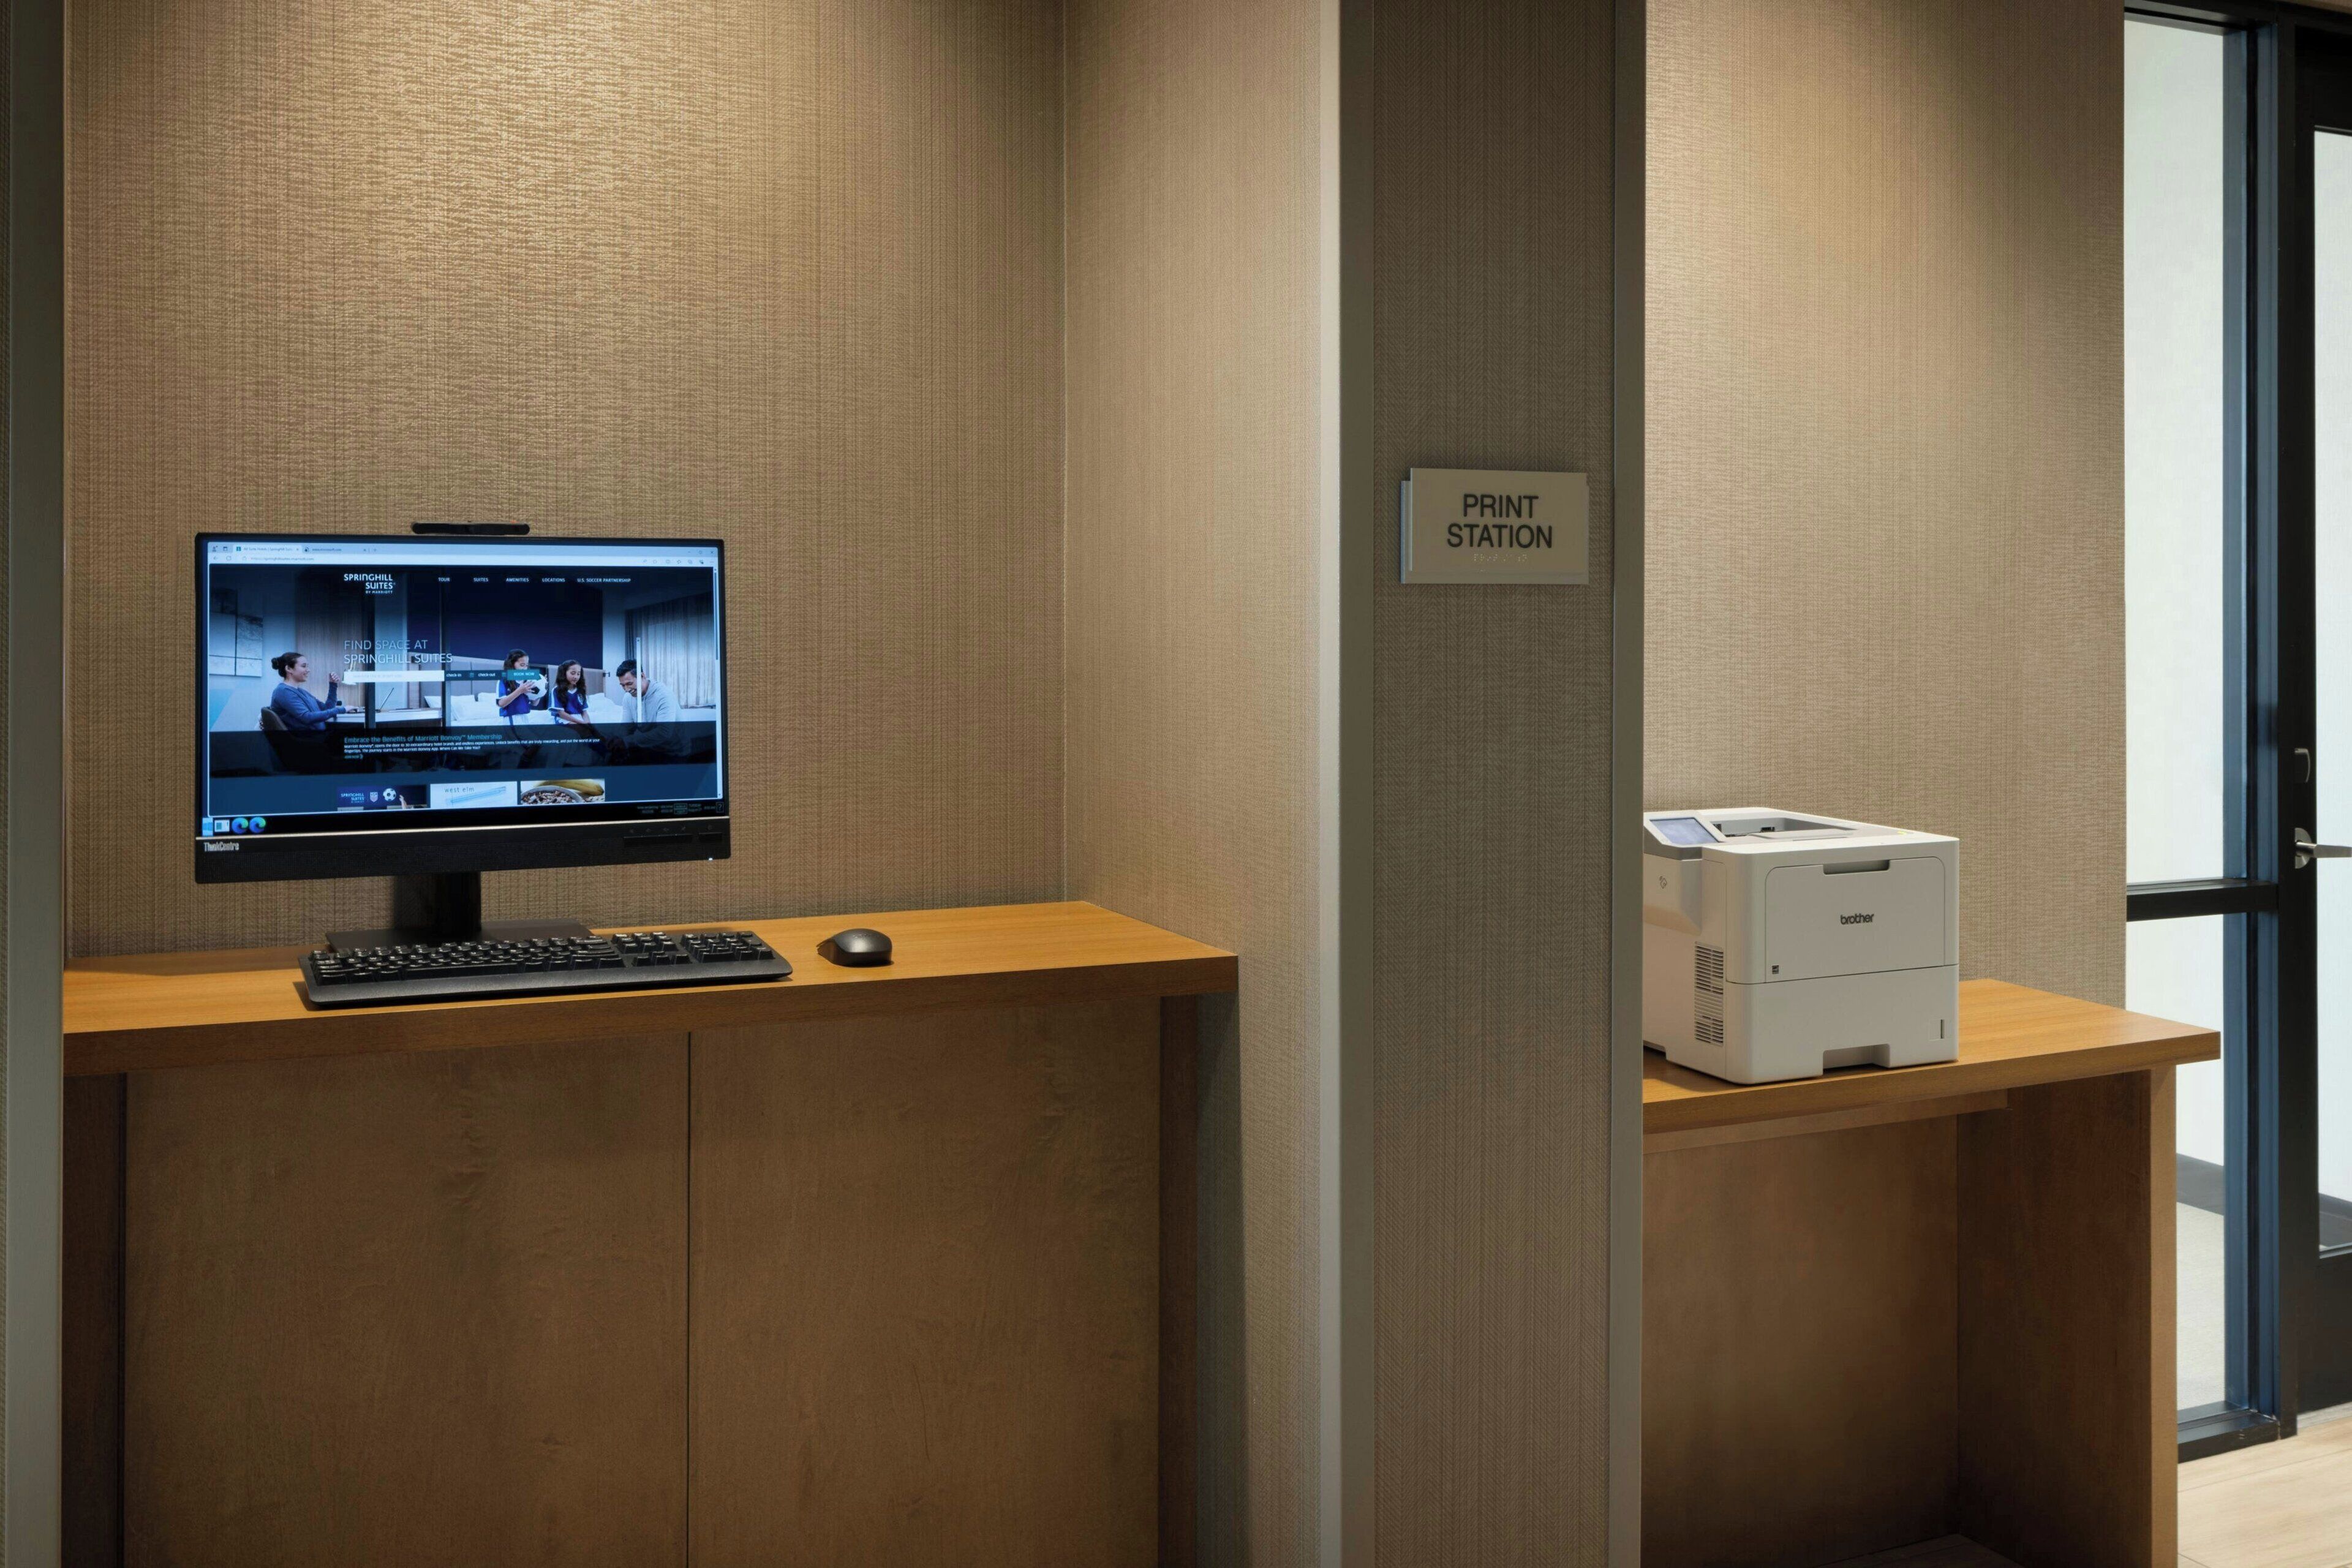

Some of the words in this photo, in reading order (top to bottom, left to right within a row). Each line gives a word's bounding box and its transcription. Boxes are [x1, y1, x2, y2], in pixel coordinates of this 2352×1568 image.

[1463, 494, 1539, 518] PRINT
[1447, 523, 1552, 548] STATION
[344, 640, 371, 650] FIND
[375, 639, 410, 649] SPACE
[414, 639, 428, 649] AT
[344, 654, 411, 664] SPRINGHILL
[414, 653, 453, 663] SUITES
[203, 842, 239, 851] ThinkCentre
[1840, 913, 1874, 925] brother
